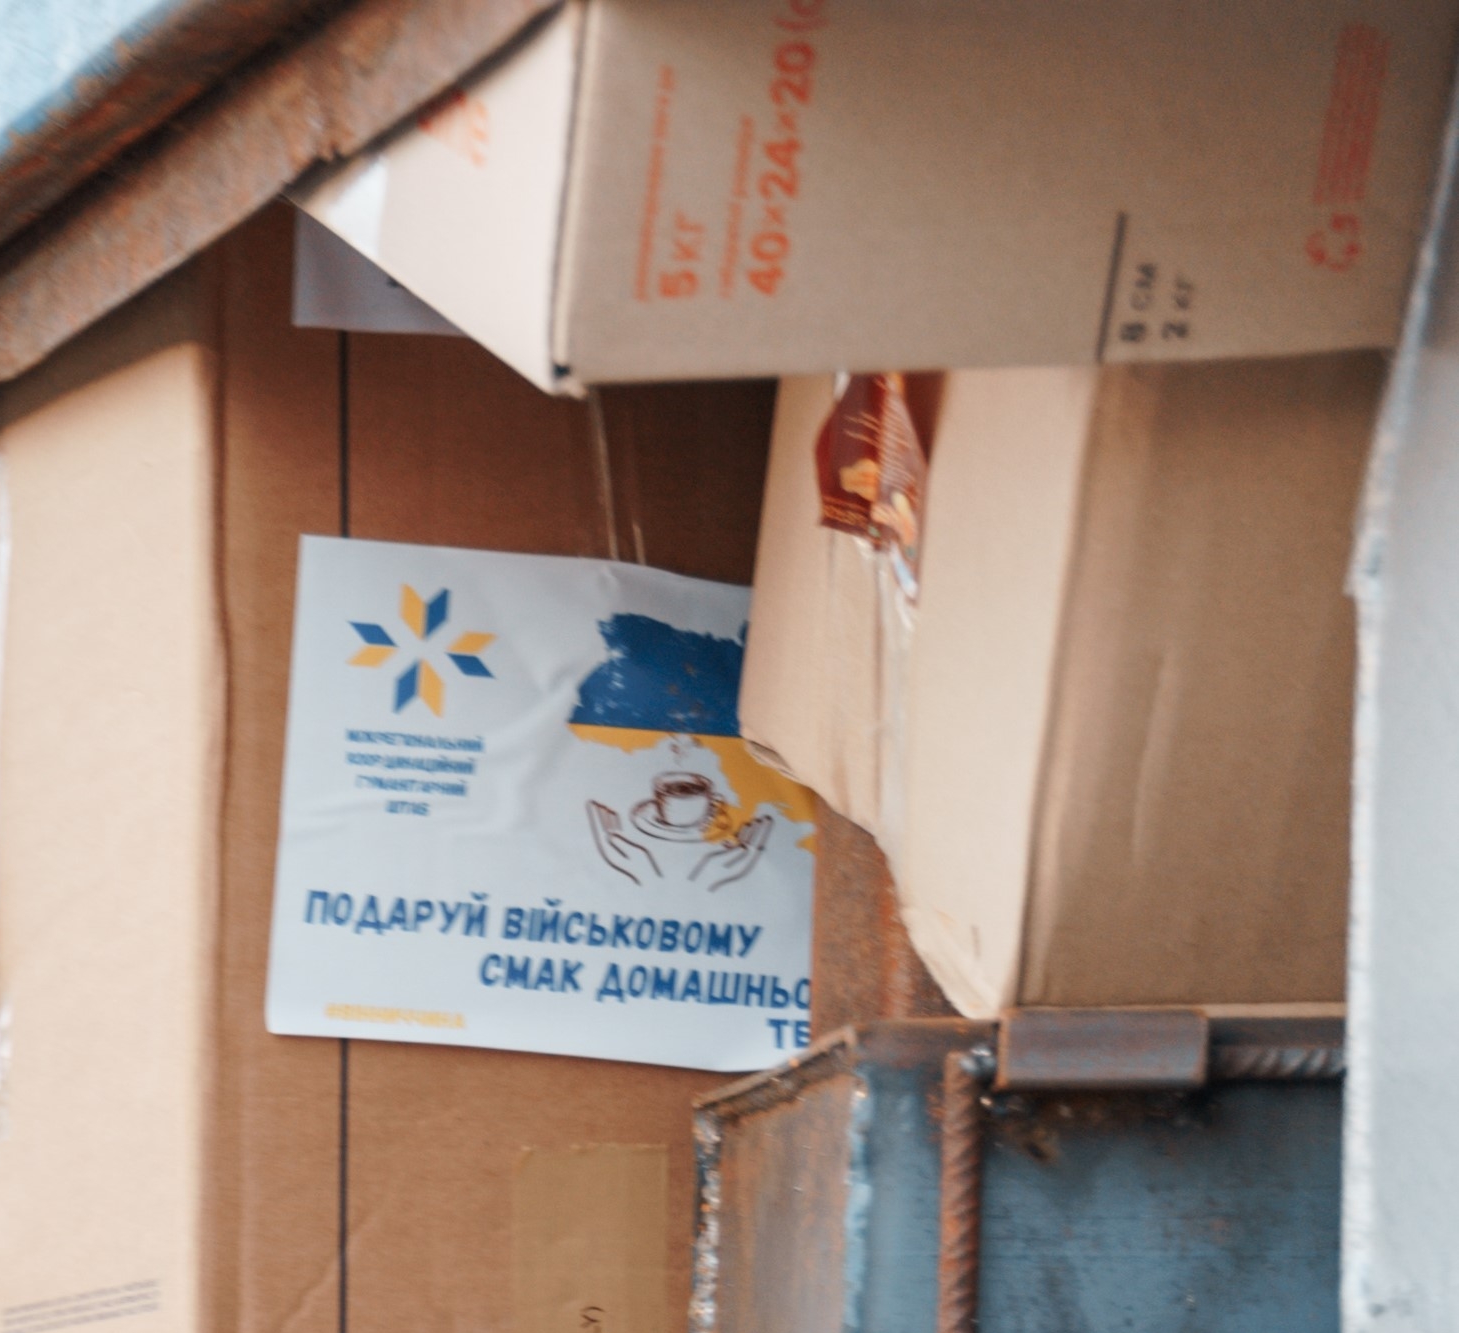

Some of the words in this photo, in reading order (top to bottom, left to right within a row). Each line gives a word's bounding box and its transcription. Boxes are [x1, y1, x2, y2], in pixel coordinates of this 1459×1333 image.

[658, 270, 699, 300] 5
[303, 891, 490, 939] ПОДАРУЙ
[502, 898, 763, 958] ВІЙСЬКОВОМУ
[479, 953, 586, 993] СМАК
